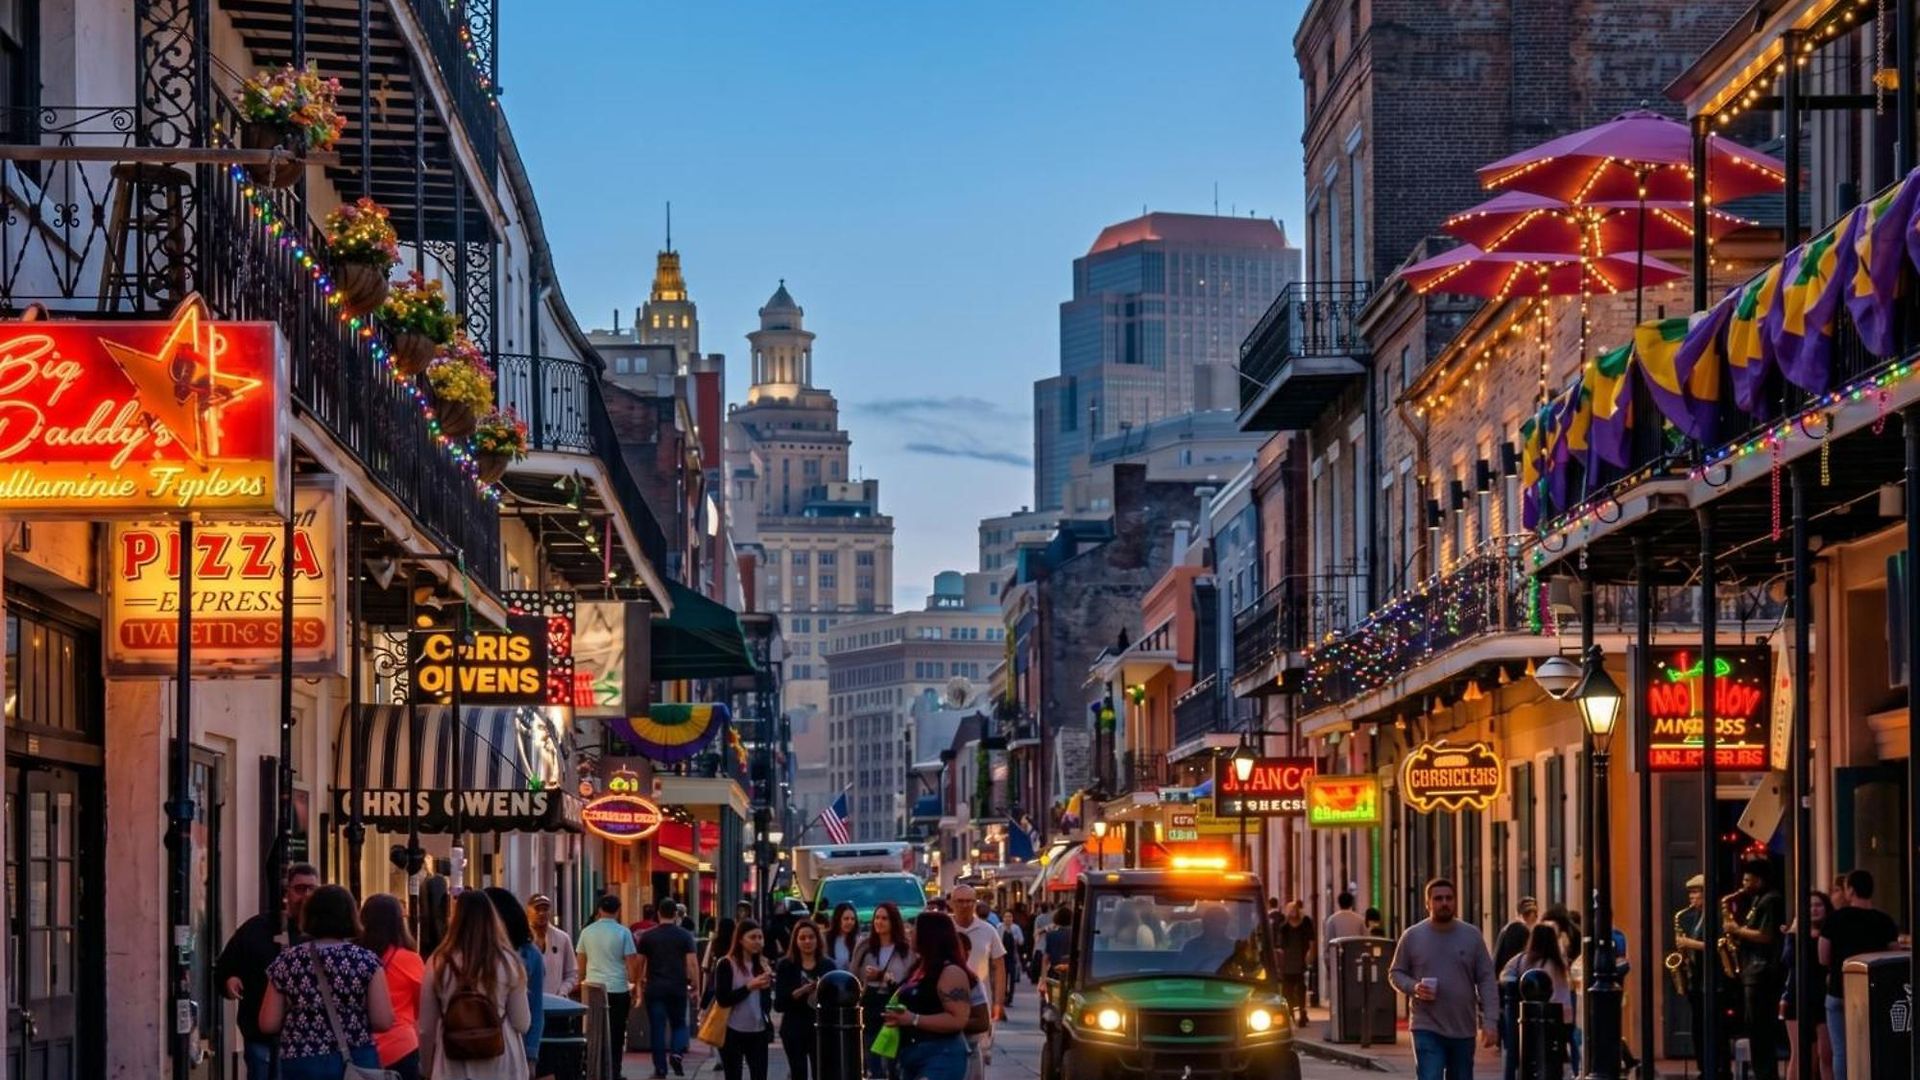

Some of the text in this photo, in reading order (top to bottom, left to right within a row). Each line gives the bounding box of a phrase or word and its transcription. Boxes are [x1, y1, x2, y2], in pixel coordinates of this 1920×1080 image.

[0, 334, 83, 406] Big
[0, 400, 173, 469] Daddy's
[122, 531, 322, 581] PIZZA
[342, 791, 430, 816] CHRIS
[444, 791, 547, 816] OWENS
